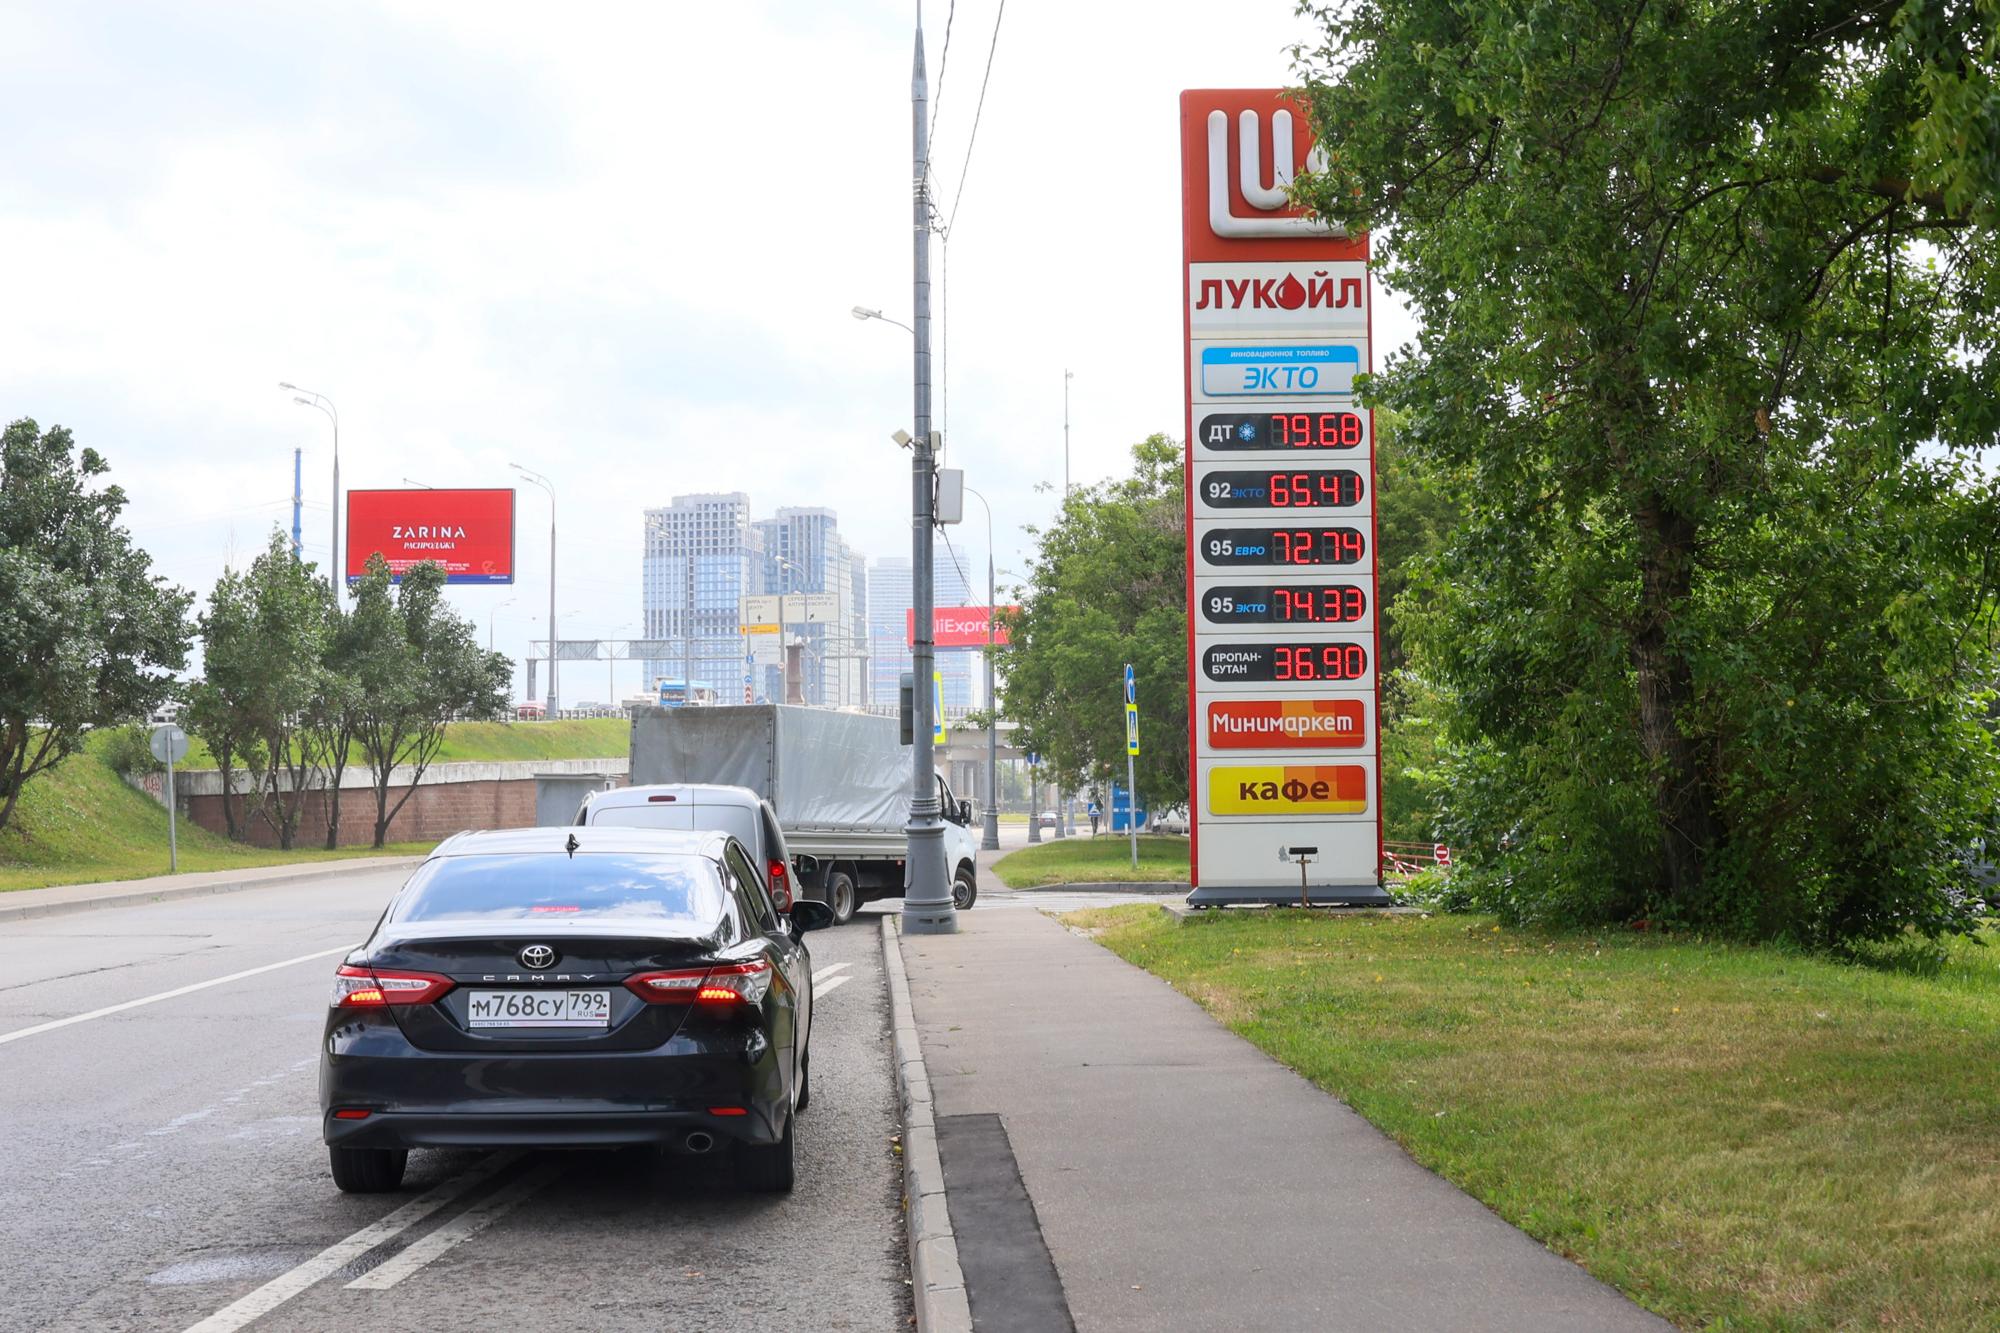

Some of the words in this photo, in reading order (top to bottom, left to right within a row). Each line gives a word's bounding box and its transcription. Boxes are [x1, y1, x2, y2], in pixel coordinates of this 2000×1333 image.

[1196, 270, 1363, 311] ЛУКОЙЛ
[1243, 366, 1319, 390] ЭКТО
[1208, 424, 1234, 443] ДТ
[1271, 414, 1360, 447] 79.68
[1209, 482, 1231, 499] 92
[1232, 487, 1265, 499] ЭКТО
[1270, 475, 1361, 506] 65.41
[392, 526, 466, 539] ZARINA
[403, 541, 456, 550] РАСПРОДАЖА
[1210, 539, 1233, 556] 95
[1235, 546, 1265, 556] ЕВРО
[1273, 532, 1361, 564] 72.74
[1210, 597, 1233, 614] 95
[1235, 604, 1267, 613] ЭКТО
[1274, 588, 1363, 622] 74.33
[1211, 652, 1262, 663] ПРОПАН-
[1275, 646, 1364, 680] 36.90
[1211, 664, 1248, 674] БУТАН
[1213, 713, 1353, 737] Минимаркет
[1239, 778, 1330, 803] кафе
[569, 993, 604, 1010] 799
[577, 1010, 594, 1018] RUS
